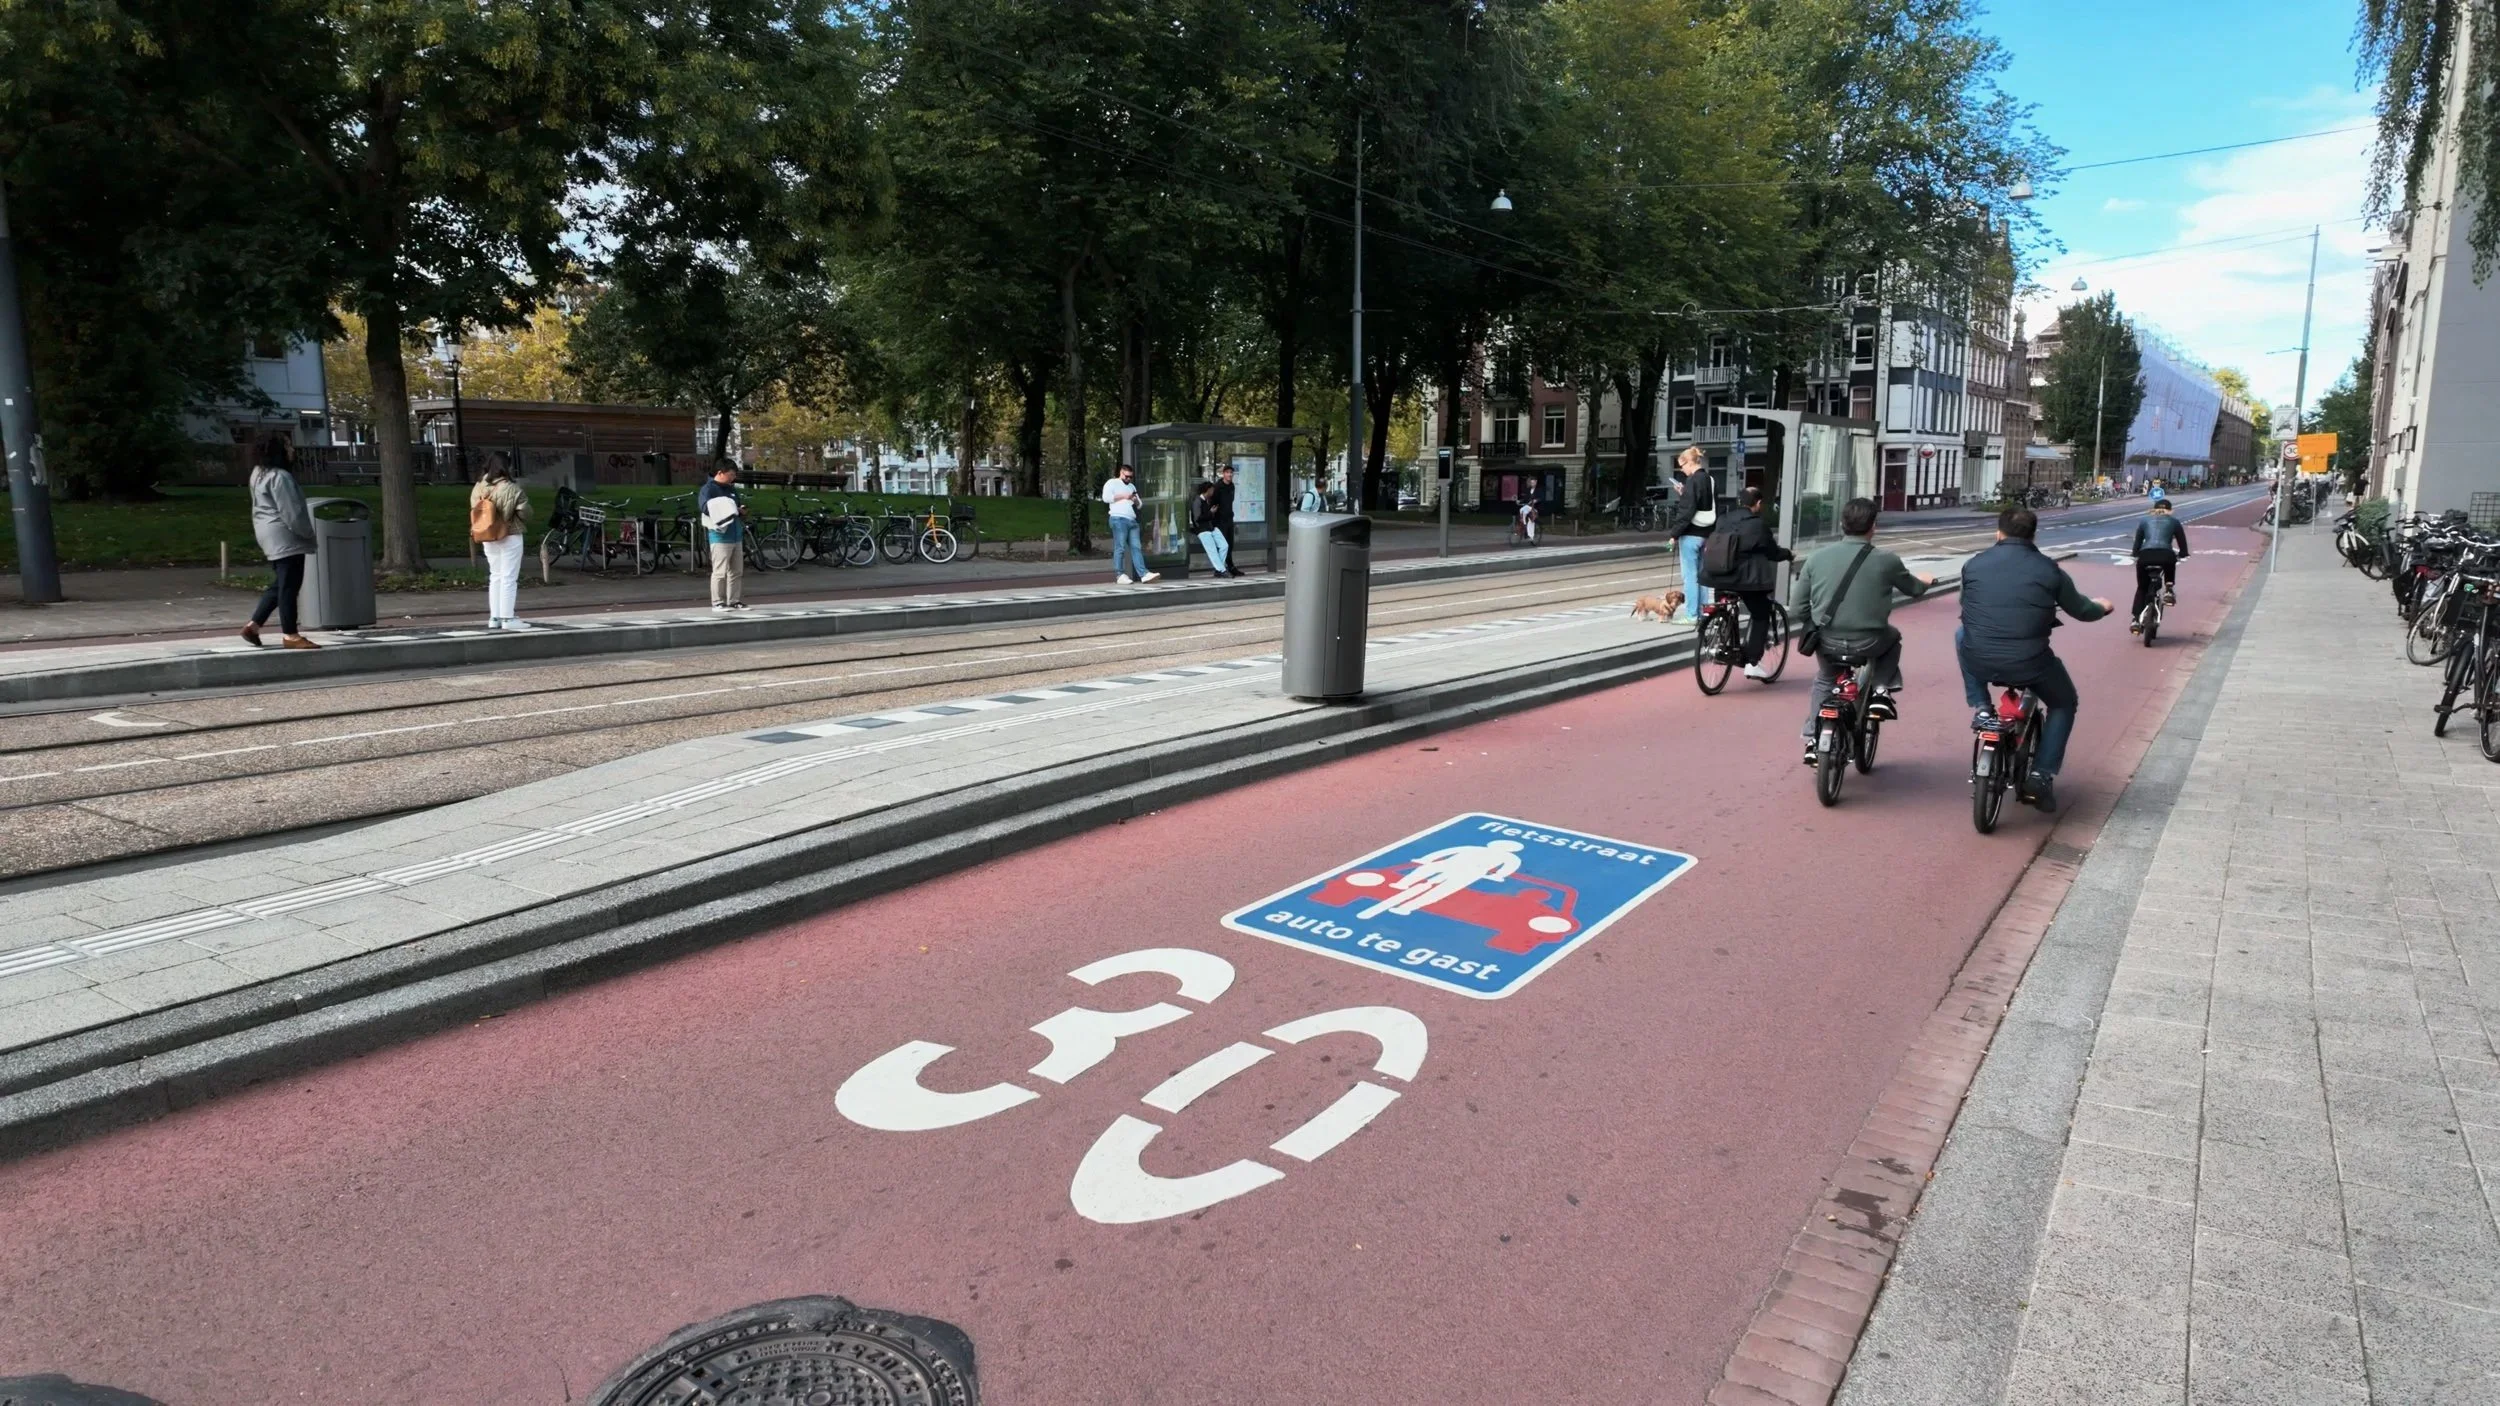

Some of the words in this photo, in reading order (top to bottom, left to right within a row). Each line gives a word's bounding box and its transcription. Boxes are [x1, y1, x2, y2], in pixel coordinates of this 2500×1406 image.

[1478, 821, 1657, 865] fietsstraat
[1265, 910, 1354, 940] auto
[1357, 932, 1402, 953] te
[1398, 948, 1500, 980] gast
[834, 947, 1429, 1224] 30
